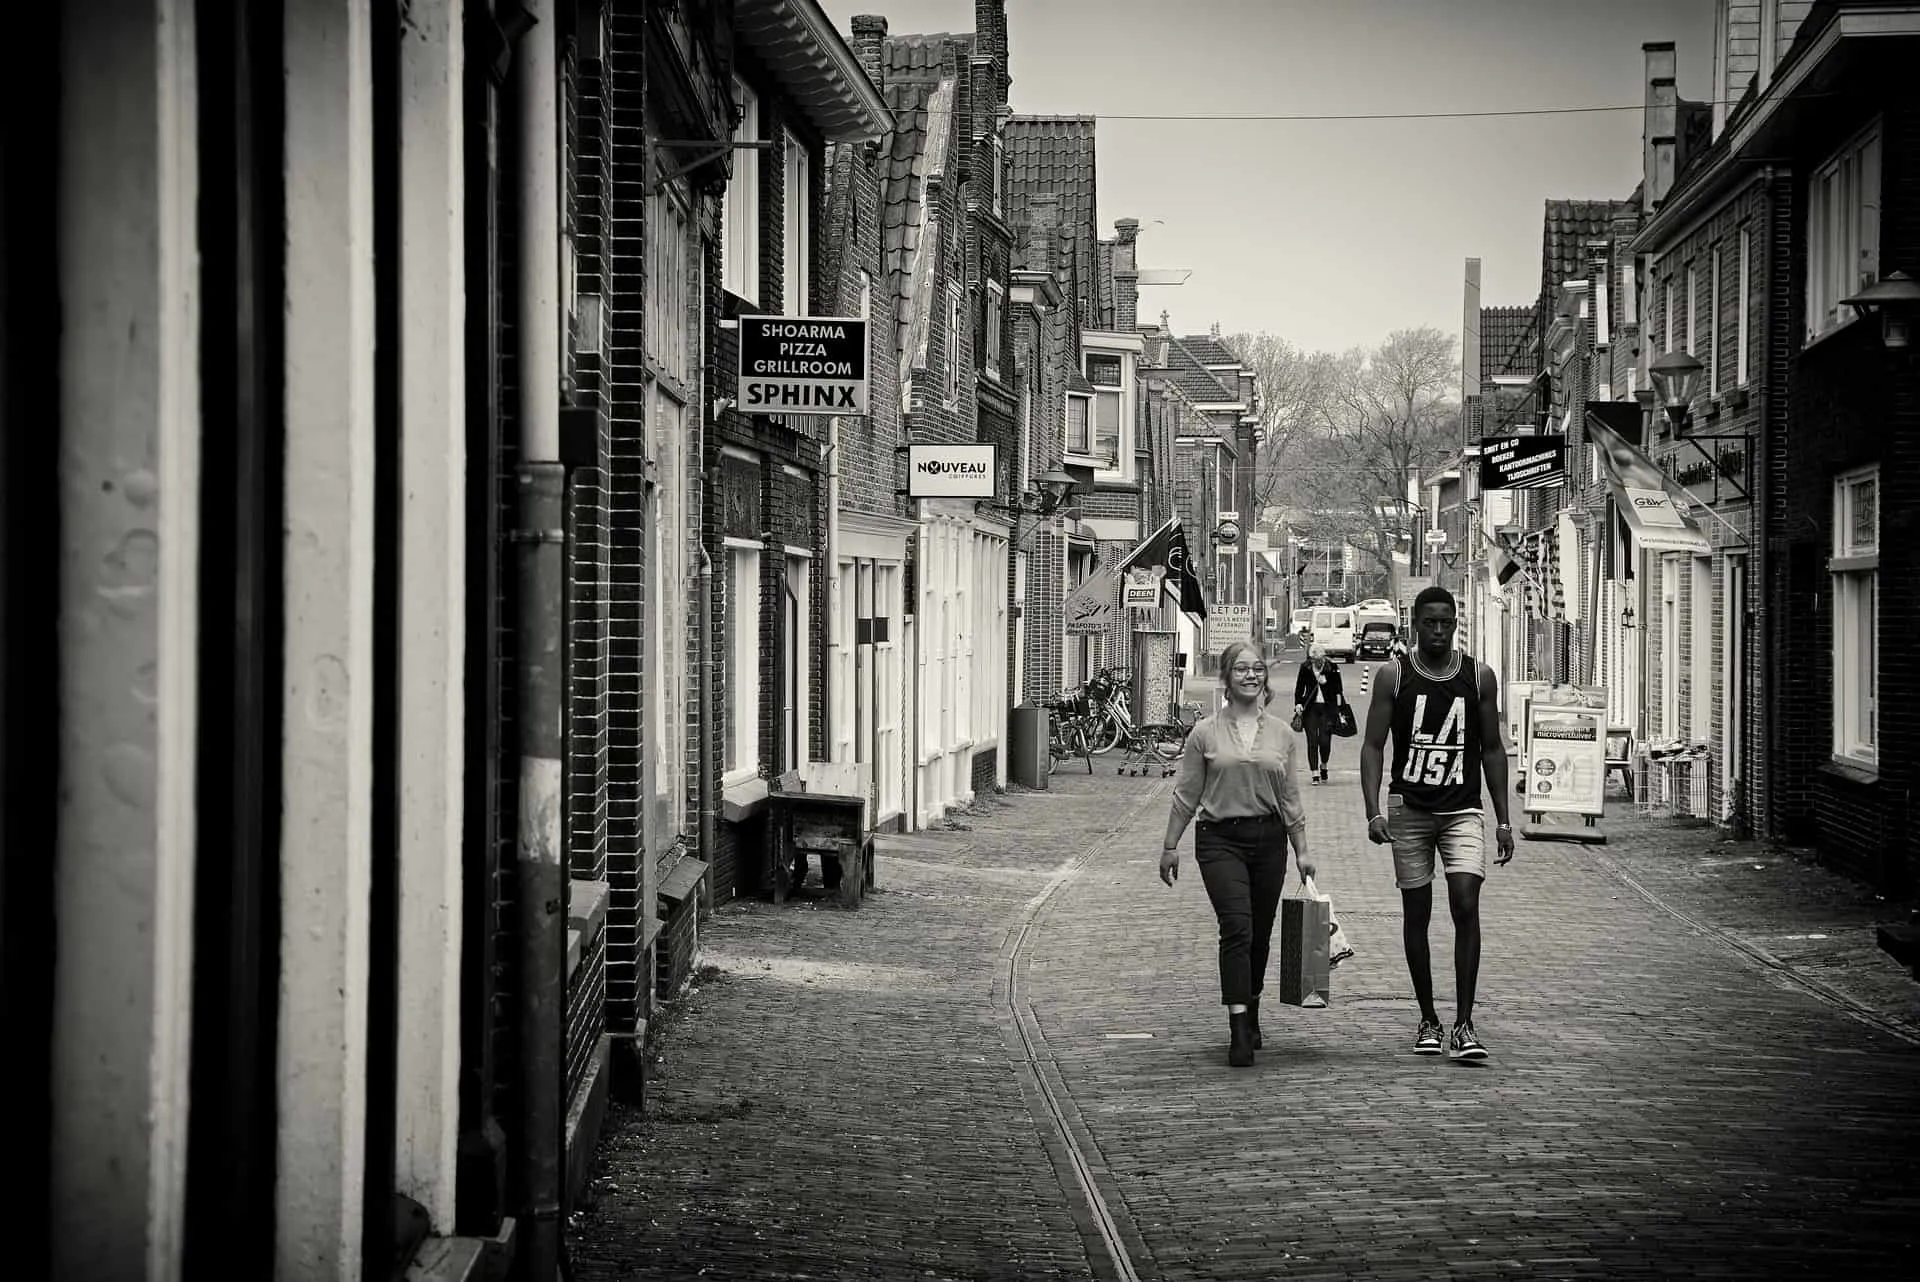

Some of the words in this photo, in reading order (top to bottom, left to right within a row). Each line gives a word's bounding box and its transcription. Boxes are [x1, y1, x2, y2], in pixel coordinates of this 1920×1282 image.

[761, 324, 846, 339] SHOARMA
[779, 342, 827, 356] PIZZA
[754, 359, 852, 375] GRILLROOM
[747, 383, 856, 407] SPHINX
[1500, 441, 1509, 450] EN
[1510, 438, 1519, 447] CO
[1491, 450, 1515, 464] BOEKEN
[1499, 449, 1556, 472] KANTOORMACHINES
[918, 460, 986, 475] NOUVEAU
[1507, 462, 1552, 481] TIJDSCHRIFTEN
[1211, 606, 1230, 615] LET
[1233, 606, 1250, 615] OP!
[1410, 694, 1466, 744] LA
[1402, 748, 1464, 786] USA
